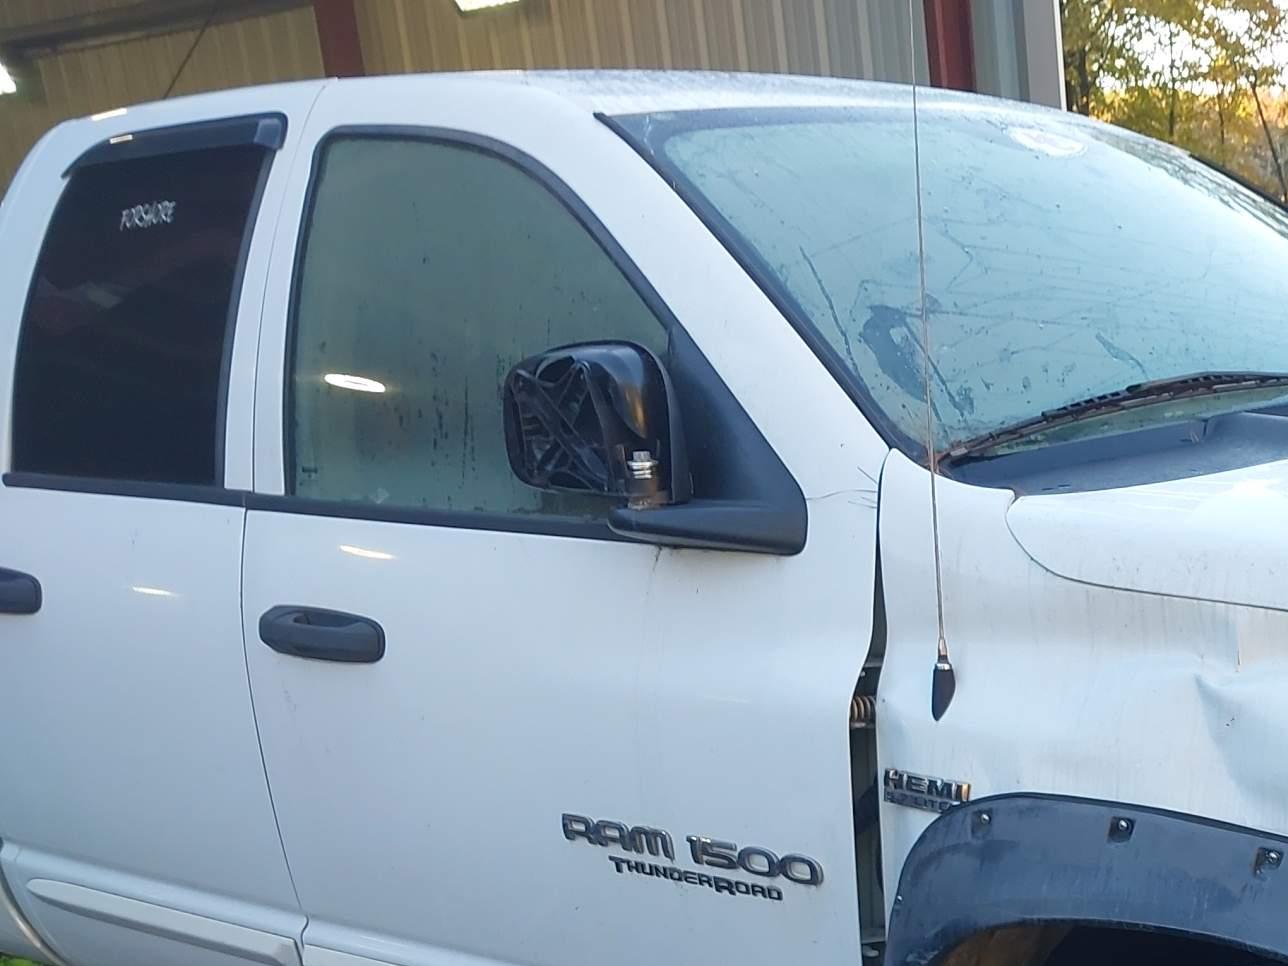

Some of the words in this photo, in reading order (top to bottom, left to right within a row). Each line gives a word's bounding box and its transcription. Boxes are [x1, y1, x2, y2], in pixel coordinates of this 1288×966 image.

[884, 768, 970, 802] HEMI
[561, 812, 675, 862] RAM
[686, 835, 824, 886] 1500
